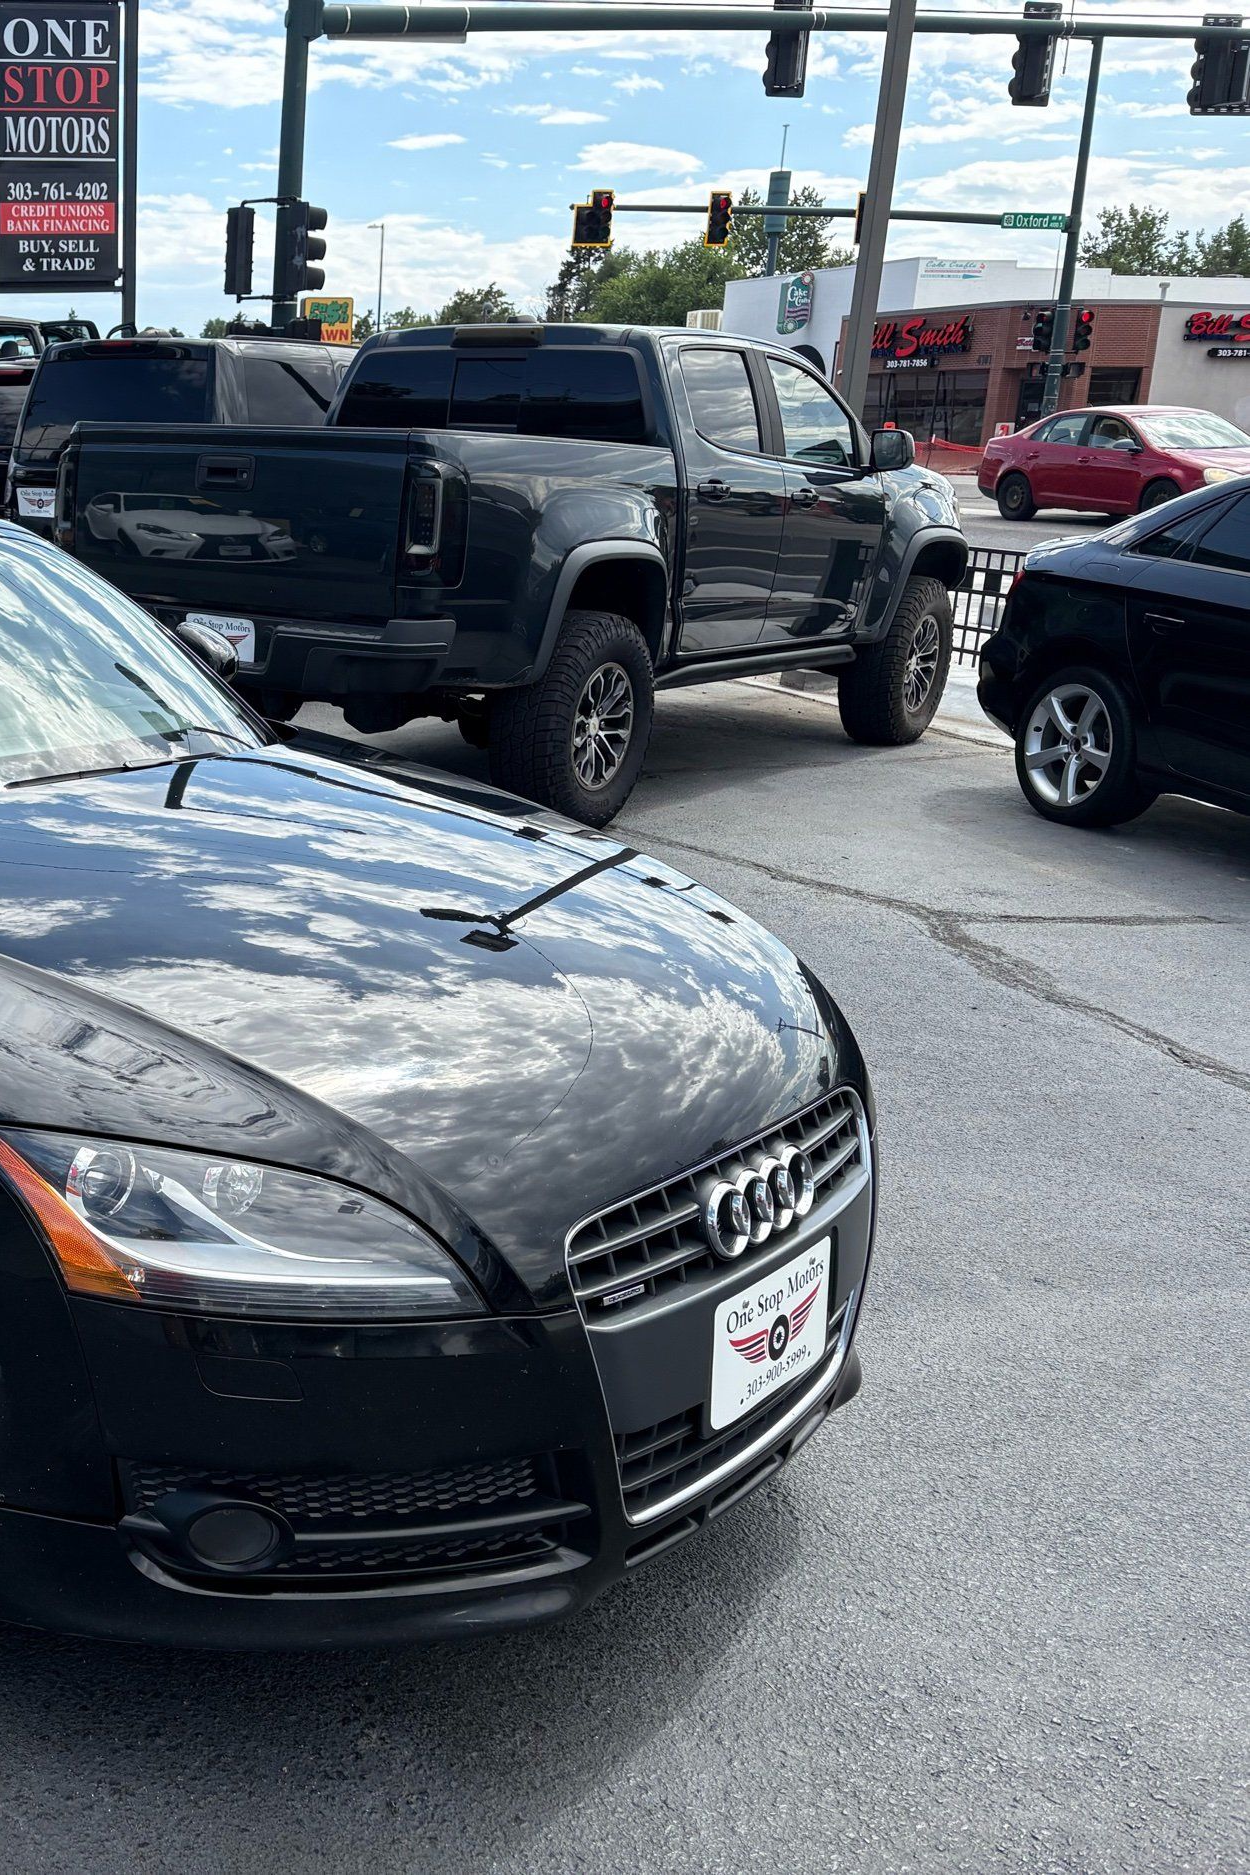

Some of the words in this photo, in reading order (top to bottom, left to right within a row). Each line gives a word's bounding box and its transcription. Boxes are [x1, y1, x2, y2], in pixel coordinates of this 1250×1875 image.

[3, 18, 111, 57] ONE
[4, 66, 110, 104] STOP
[4, 116, 110, 154] MOTORS
[11, 205, 57, 217] CREDIT
[60, 205, 105, 217] UNIONS
[7, 220, 40, 232] BANK
[43, 220, 110, 232] FINANCING
[1016, 214, 1050, 228] Oxford
[18, 240, 55, 256] BUY,
[58, 240, 100, 253] SELL
[22, 258, 36, 271] &
[39, 258, 96, 271] TRADE
[787, 286, 808, 301] Cake
[1189, 311, 1234, 335] Bill
[320, 329, 349, 341] AWN
[870, 322, 897, 350] ill
[895, 314, 970, 357] Smith
[886, 359, 928, 369] 303-781-7856
[208, 619, 224, 632] Stop
[225, 621, 251, 633] Motors
[726, 1308, 754, 1334] One
[757, 1289, 784, 1317] Stop
[787, 1260, 824, 1299] Motors
[745, 1344, 807, 1400] 303-900-5999
